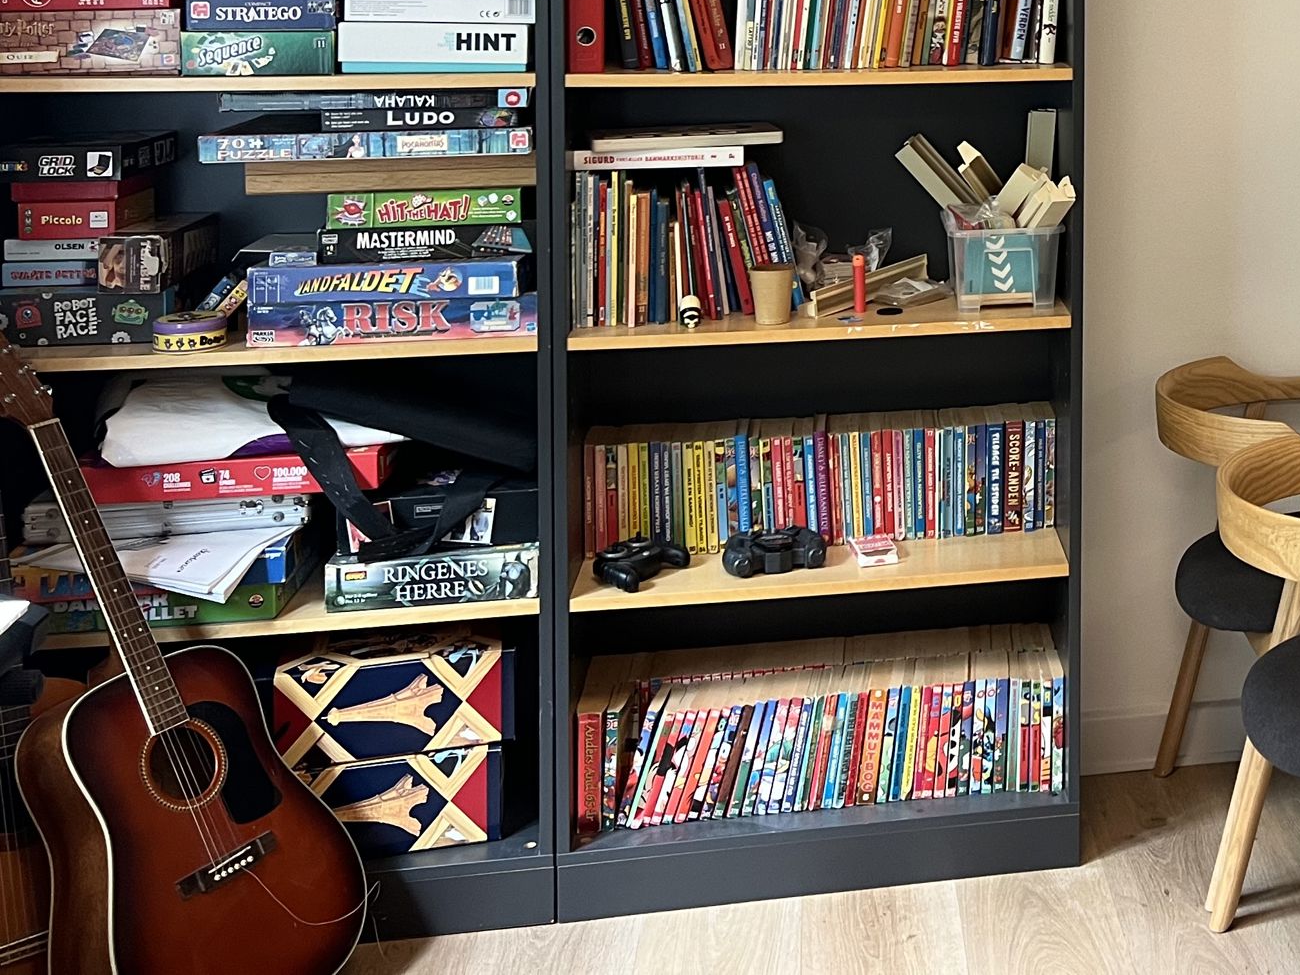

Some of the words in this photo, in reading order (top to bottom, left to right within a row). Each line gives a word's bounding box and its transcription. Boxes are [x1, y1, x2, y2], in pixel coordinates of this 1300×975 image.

[216, 6, 302, 22] STRATEGO
[954, 2, 963, 29] VILDESTE
[1017, 7, 1030, 40] VERDEN
[198, 36, 262, 66] Sequence
[456, 32, 516, 52] HINT
[374, 95, 435, 107] KALAHA
[387, 110, 455, 126] LUDO
[217, 138, 244, 149] 70
[39, 155, 75, 166] GRID
[217, 149, 292, 160] PUZZLE
[584, 156, 615, 164] SIGURD
[39, 165, 75, 176] LOCK
[424, 195, 471, 222] HAT!
[41, 215, 82, 225] Piccolo
[356, 228, 456, 250] MASTERMIND
[298, 267, 424, 294] VANDFALDET
[54, 298, 96, 312] ROBOT
[55, 309, 97, 324] FACE
[341, 300, 452, 335] RISK
[56, 322, 97, 339] RACE
[990, 432, 1000, 466] TILBAGE
[163, 473, 180, 483] 208
[219, 470, 230, 480] 74
[991, 467, 1000, 484] TIL
[1007, 434, 1021, 506] SCORE-ANDEN
[991, 485, 1000, 516] ISTIDEN
[383, 560, 488, 583] RINGENES
[395, 581, 466, 602] HERRE
[585, 725, 597, 764] Anders
[861, 702, 883, 792] MAMMUTBOG
[585, 767, 597, 790] And
[585, 793, 595, 807] 65
